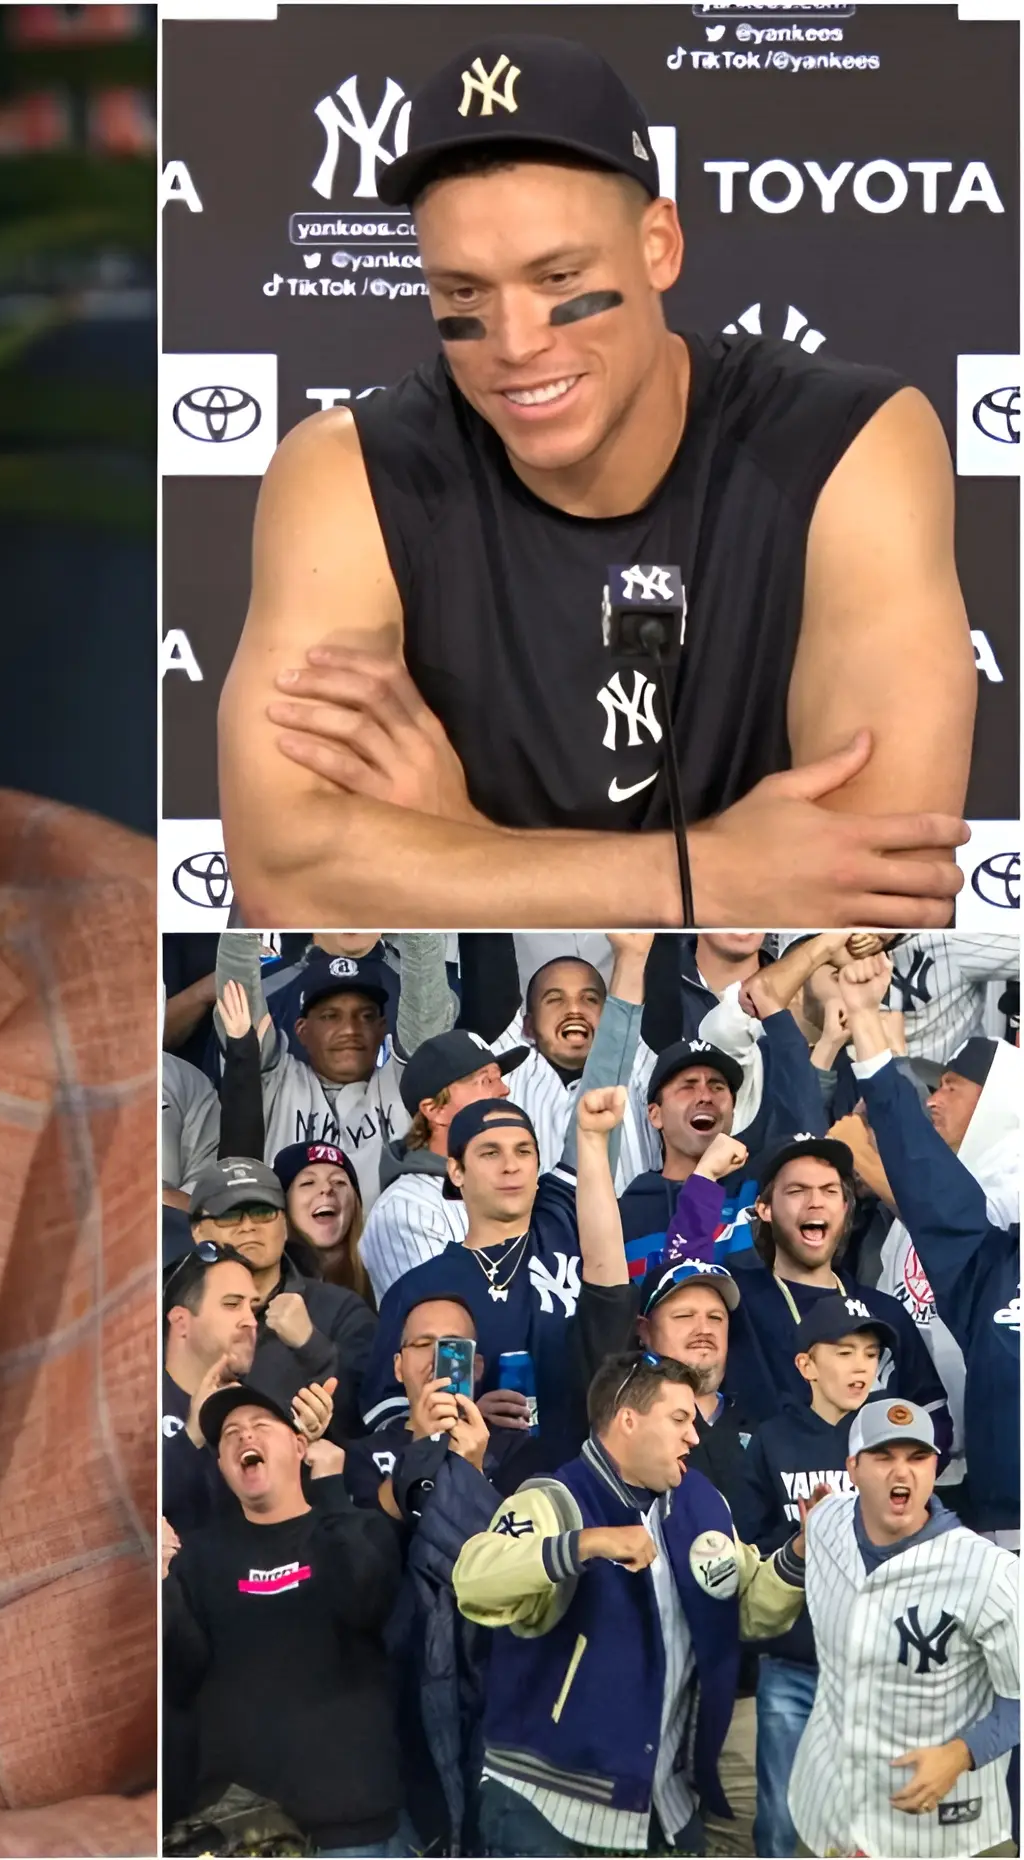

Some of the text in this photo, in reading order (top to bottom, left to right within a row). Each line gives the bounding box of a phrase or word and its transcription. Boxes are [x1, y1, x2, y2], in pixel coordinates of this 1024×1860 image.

[458, 54, 521, 116] NY
[312, 75, 412, 199] NY
[703, 159, 1005, 214] TOYOTA
[286, 278, 357, 296] TikTok
[620, 564, 674, 600] NY
[597, 670, 663, 751] NY
[893, 1604, 958, 1674] NY
